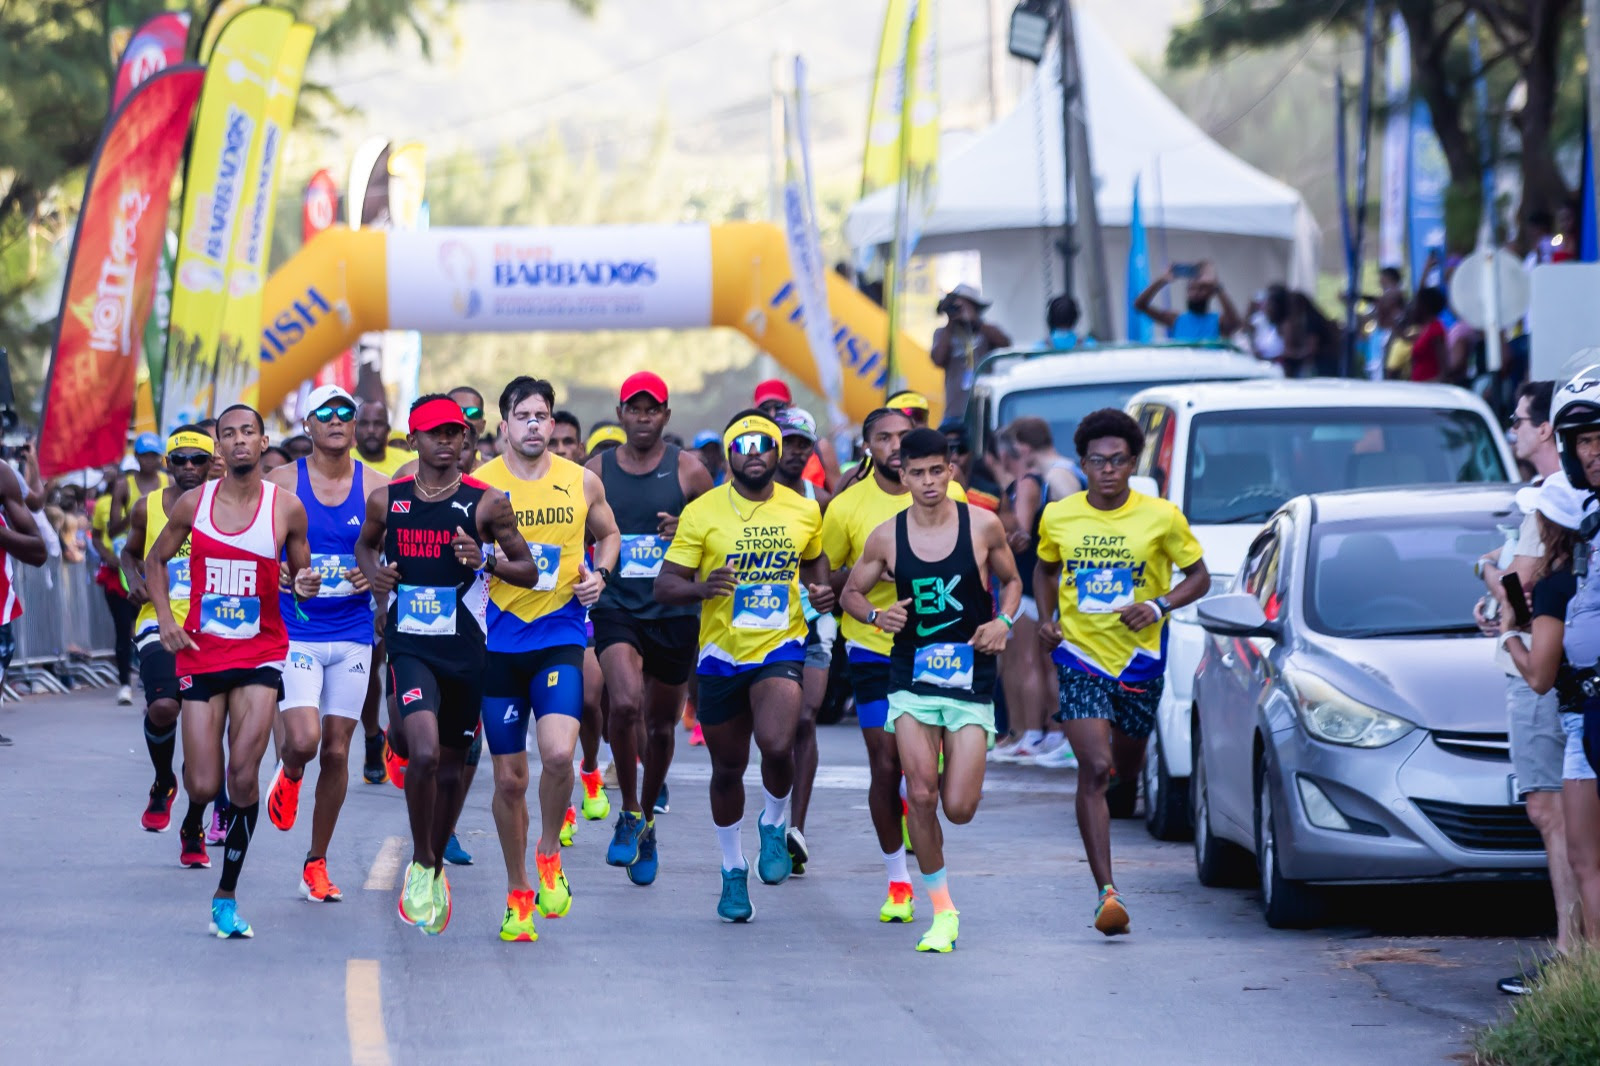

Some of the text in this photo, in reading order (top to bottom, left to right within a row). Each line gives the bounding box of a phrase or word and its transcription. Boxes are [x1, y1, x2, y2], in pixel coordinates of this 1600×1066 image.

[494, 260, 656, 287] BARBADOS
[89, 257, 131, 351] HOTT
[397, 527, 451, 545] TRINIDAD
[743, 526, 786, 538] START
[735, 538, 796, 551] STRONG.
[1082, 535, 1126, 547] START
[397, 542, 441, 558] TOBAGO
[630, 546, 663, 559] 1170
[1073, 547, 1134, 560] STRONG.
[725, 550, 803, 570] FINISH
[313, 565, 348, 579] 1275
[1085, 580, 1124, 595] 1024
[410, 599, 442, 615] 1115
[742, 595, 781, 610] 1240
[214, 605, 246, 621] 1114
[294, 661, 312, 672] LCA
[925, 655, 962, 670] 1014
